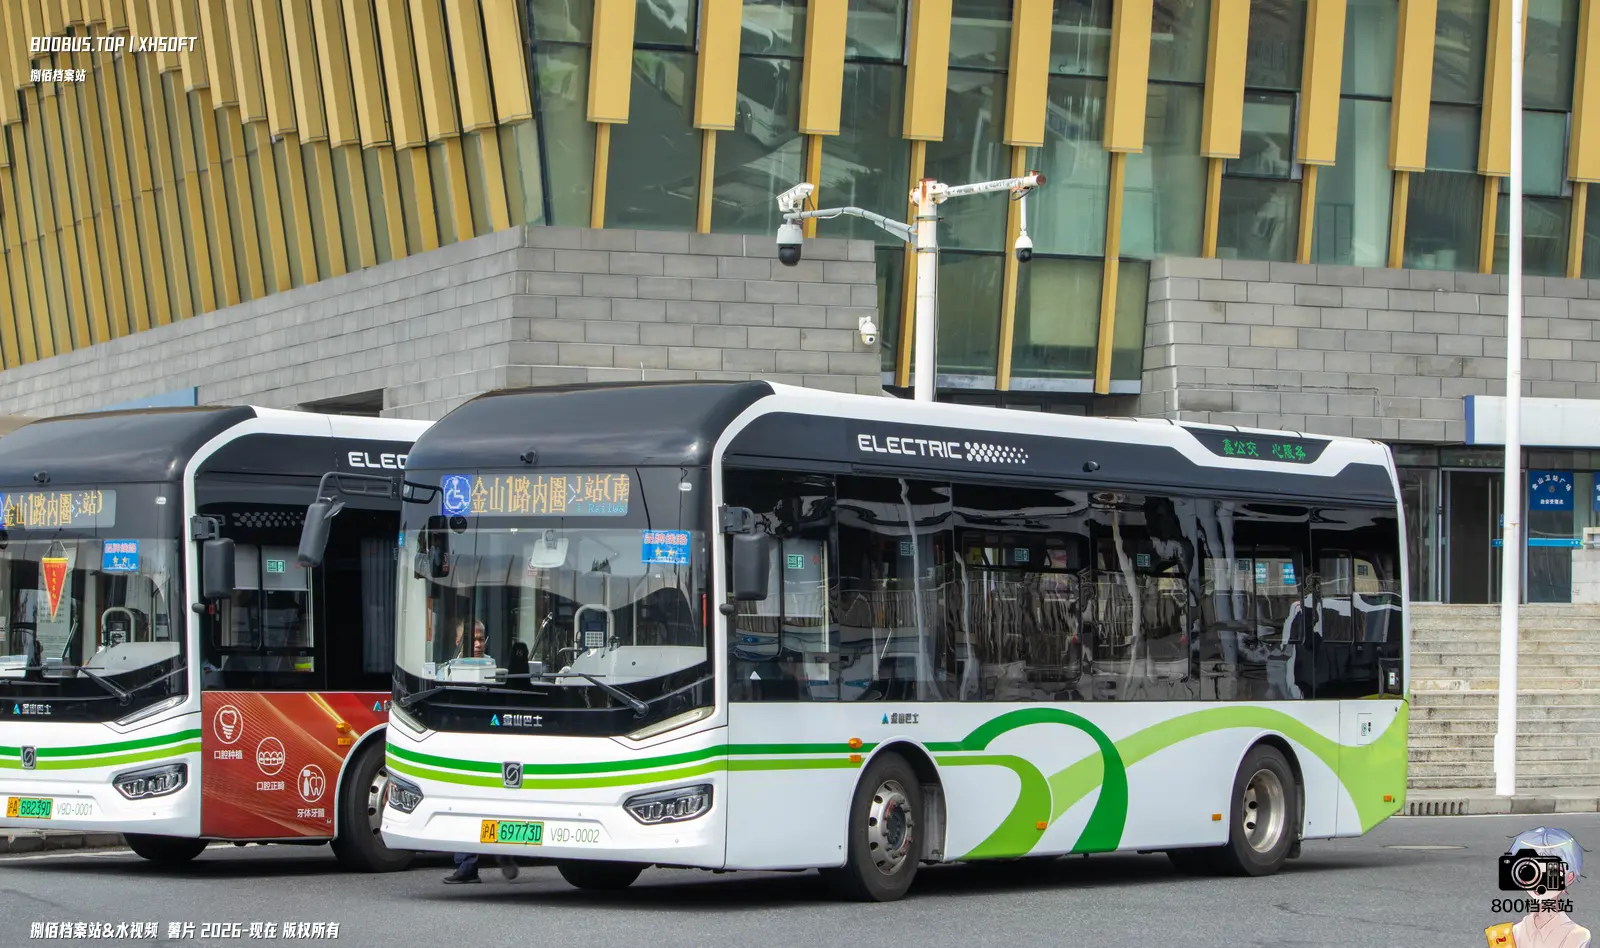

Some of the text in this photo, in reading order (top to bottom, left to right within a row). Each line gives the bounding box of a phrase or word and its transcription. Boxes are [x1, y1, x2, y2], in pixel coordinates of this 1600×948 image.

[858, 434, 962, 459] ELECTRIC
[503, 714, 543, 727] 金山巴士
[214, 750, 243, 760] 口腔种植
[256, 781, 285, 791] 口腔正畸
[57, 803, 93, 816] V9D-0001
[297, 808, 325, 818] 牙体牙髓
[550, 828, 600, 844] V9D-0002
